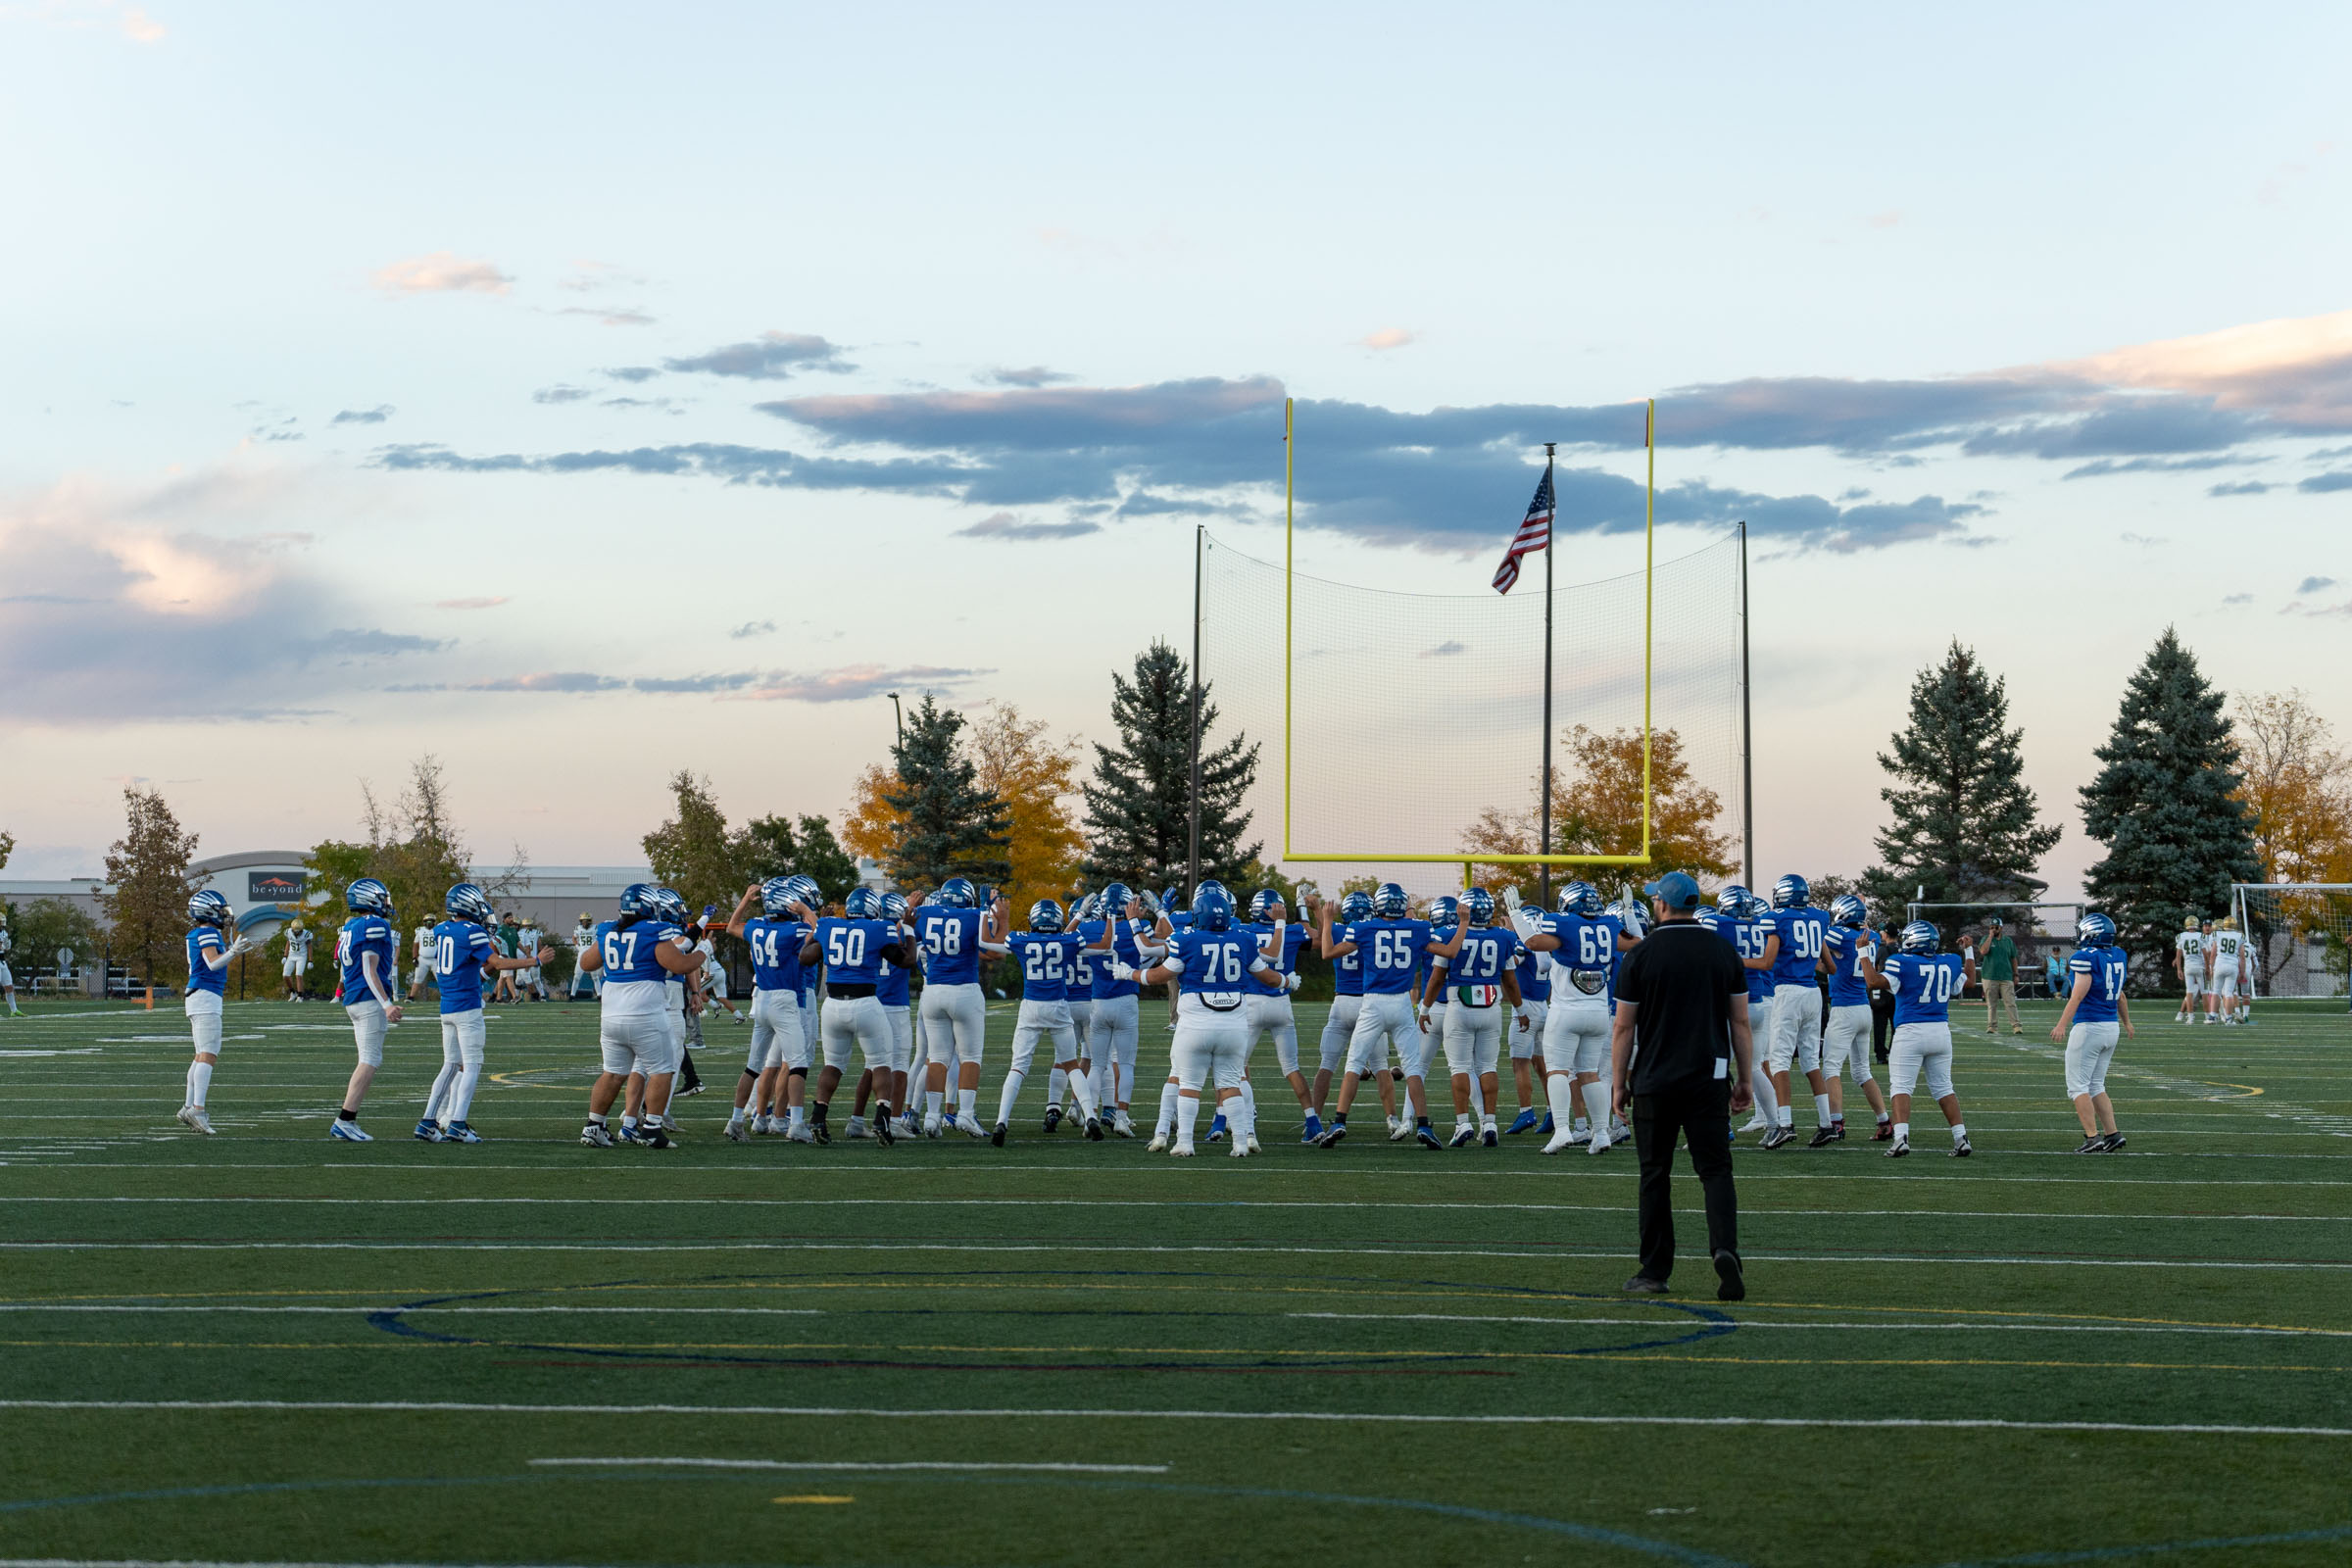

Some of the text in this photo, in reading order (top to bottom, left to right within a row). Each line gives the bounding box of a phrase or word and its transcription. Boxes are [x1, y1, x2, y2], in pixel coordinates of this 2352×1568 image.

[290, 942, 300, 952] 51
[422, 937, 435, 947] 68
[436, 935, 455, 975] 10
[580, 935, 592, 947] 58
[605, 931, 638, 970] 67
[752, 928, 779, 967] 64
[828, 927, 866, 966] 50
[925, 917, 961, 956] 58
[1374, 930, 1412, 968] 65
[1579, 925, 1612, 964] 69
[1735, 925, 1765, 958] 59
[1792, 920, 1821, 958] 90
[2183, 939, 2198, 955] 42
[2220, 937, 2236, 955] 98
[1025, 942, 1063, 980] 22
[1201, 943, 1241, 983] 76
[1460, 939, 1497, 977] 79
[1918, 964, 1952, 1004] 70
[2105, 962, 2125, 1001] 47
